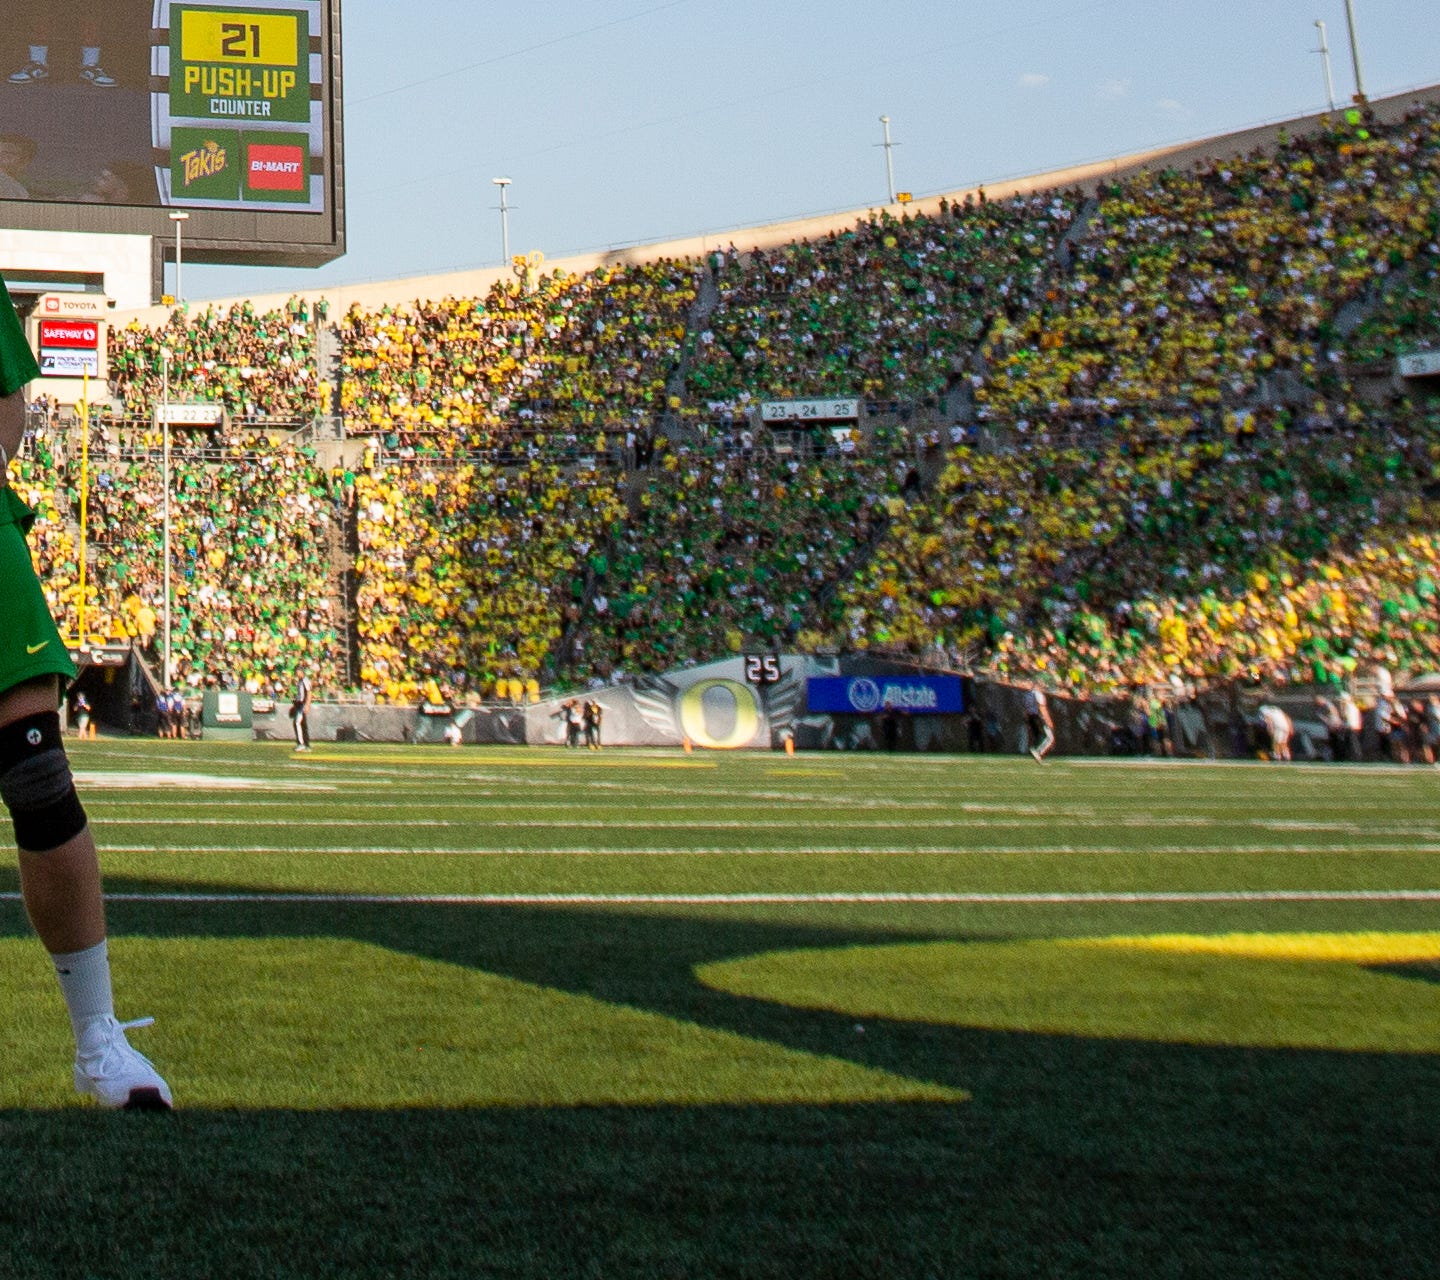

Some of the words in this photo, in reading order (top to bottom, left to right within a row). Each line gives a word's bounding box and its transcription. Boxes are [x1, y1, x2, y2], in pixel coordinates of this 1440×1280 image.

[221, 22, 261, 58] 21
[184, 65, 297, 99] PUSH-UP
[210, 98, 271, 117] COUNTER
[179, 147, 227, 187] Takis
[63, 301, 97, 311] TOYOTA
[43, 328, 83, 339] SAFEWAY
[771, 406, 786, 417] 23
[802, 405, 817, 416] 24
[834, 404, 850, 415] 25
[746, 656, 779, 682] 25
[882, 682, 937, 709] Allstate
[680, 677, 759, 749] O
